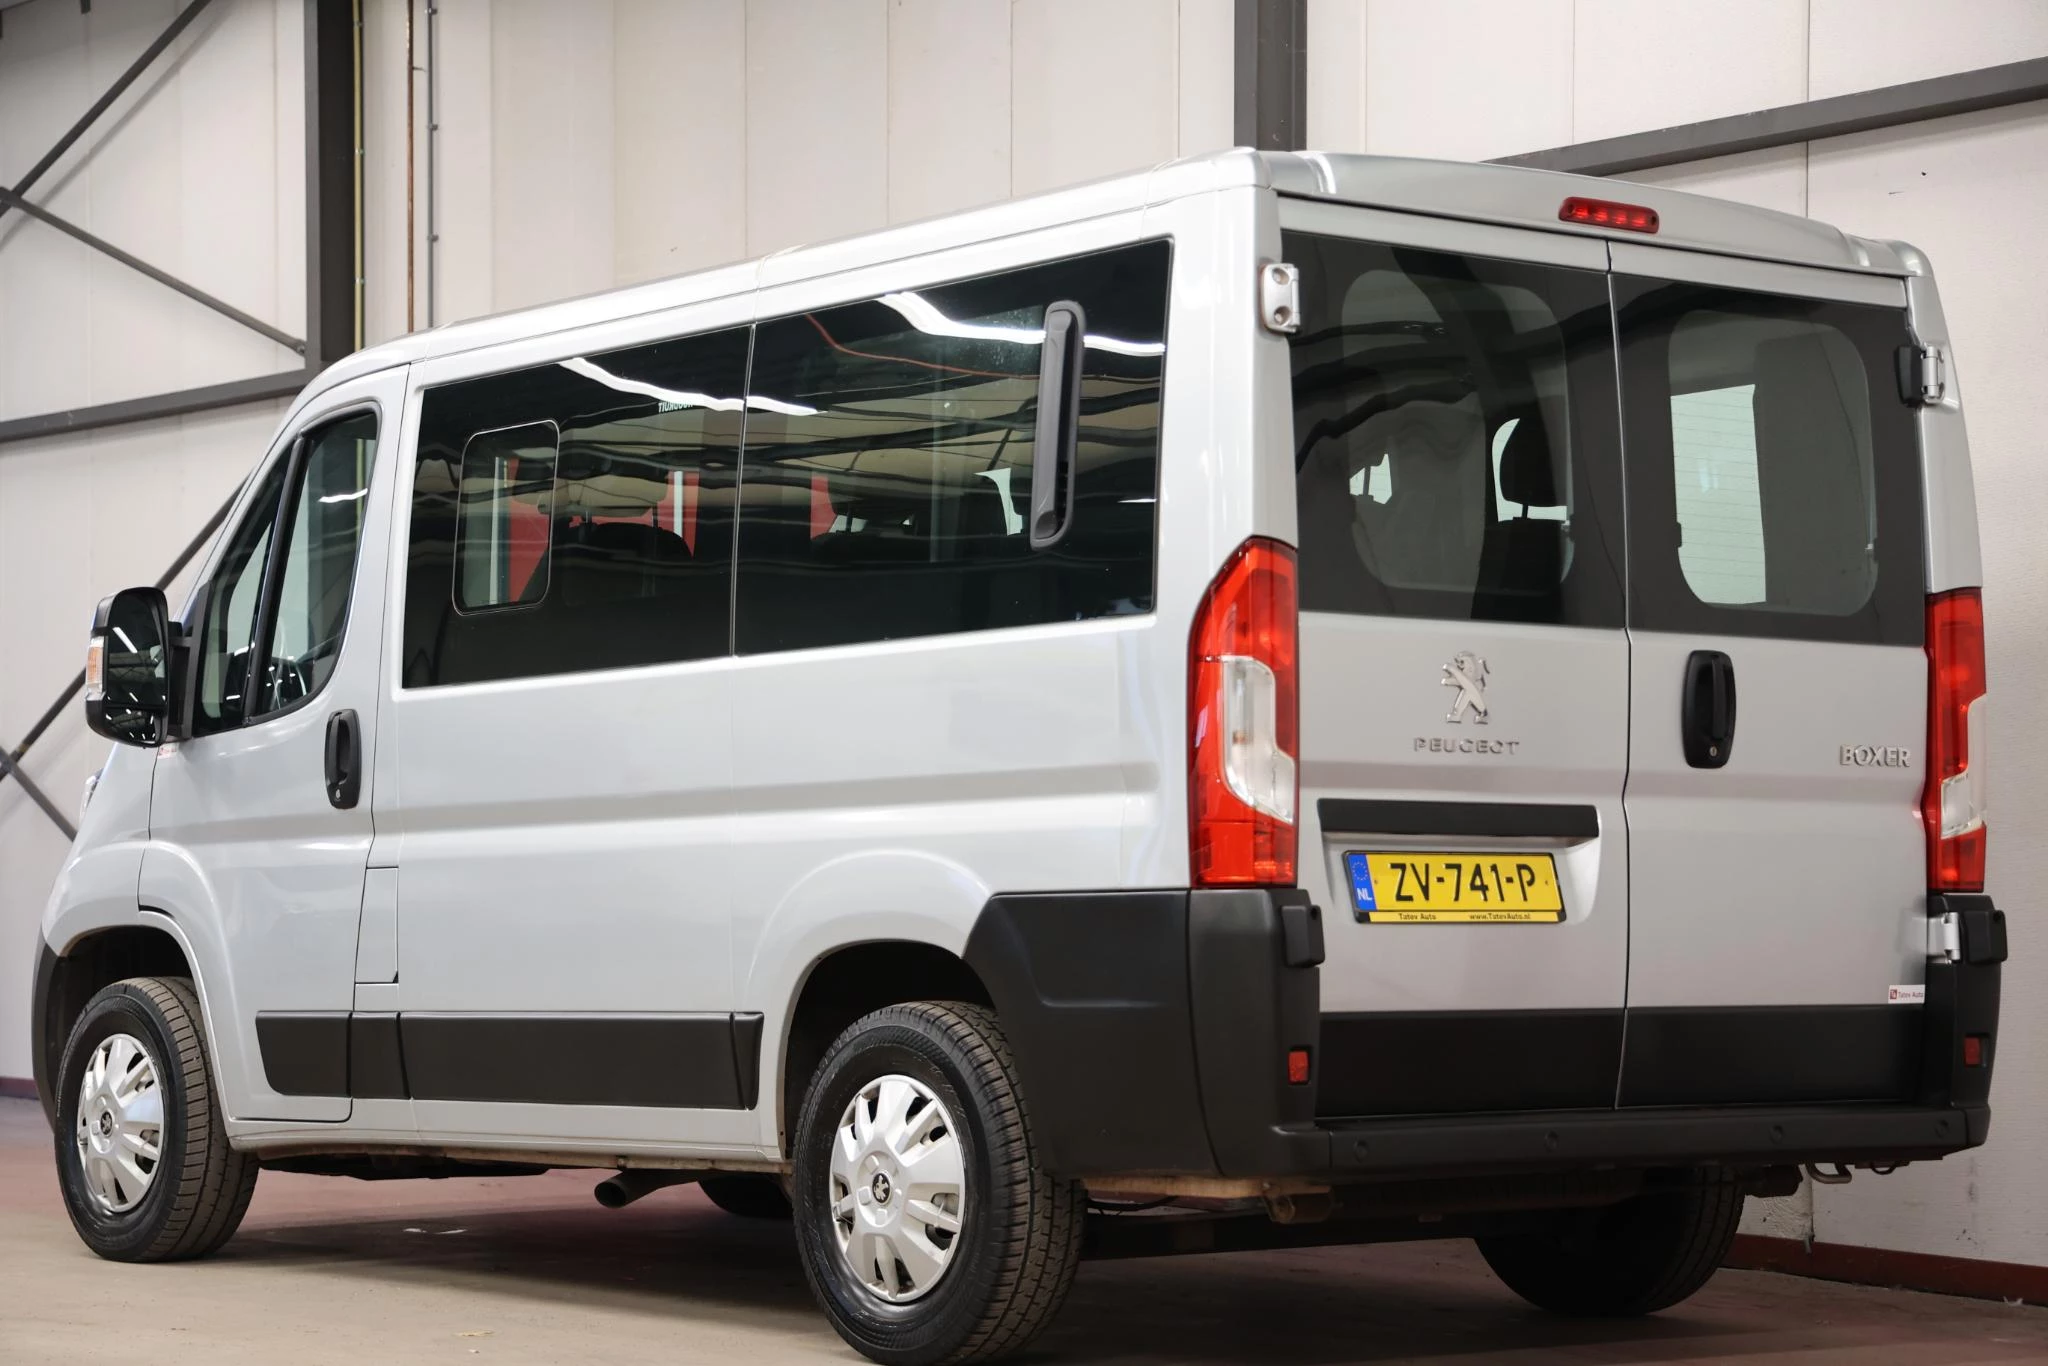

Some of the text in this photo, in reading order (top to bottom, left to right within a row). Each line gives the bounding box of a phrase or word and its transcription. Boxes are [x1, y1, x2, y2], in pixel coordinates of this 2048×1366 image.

[1413, 737, 1520, 755] PEUGEOT
[1839, 744, 1911, 768] BOXER
[1389, 863, 1536, 902] ZV-741-P
[1356, 887, 1373, 901] NL
[1420, 912, 1437, 920] Auto
